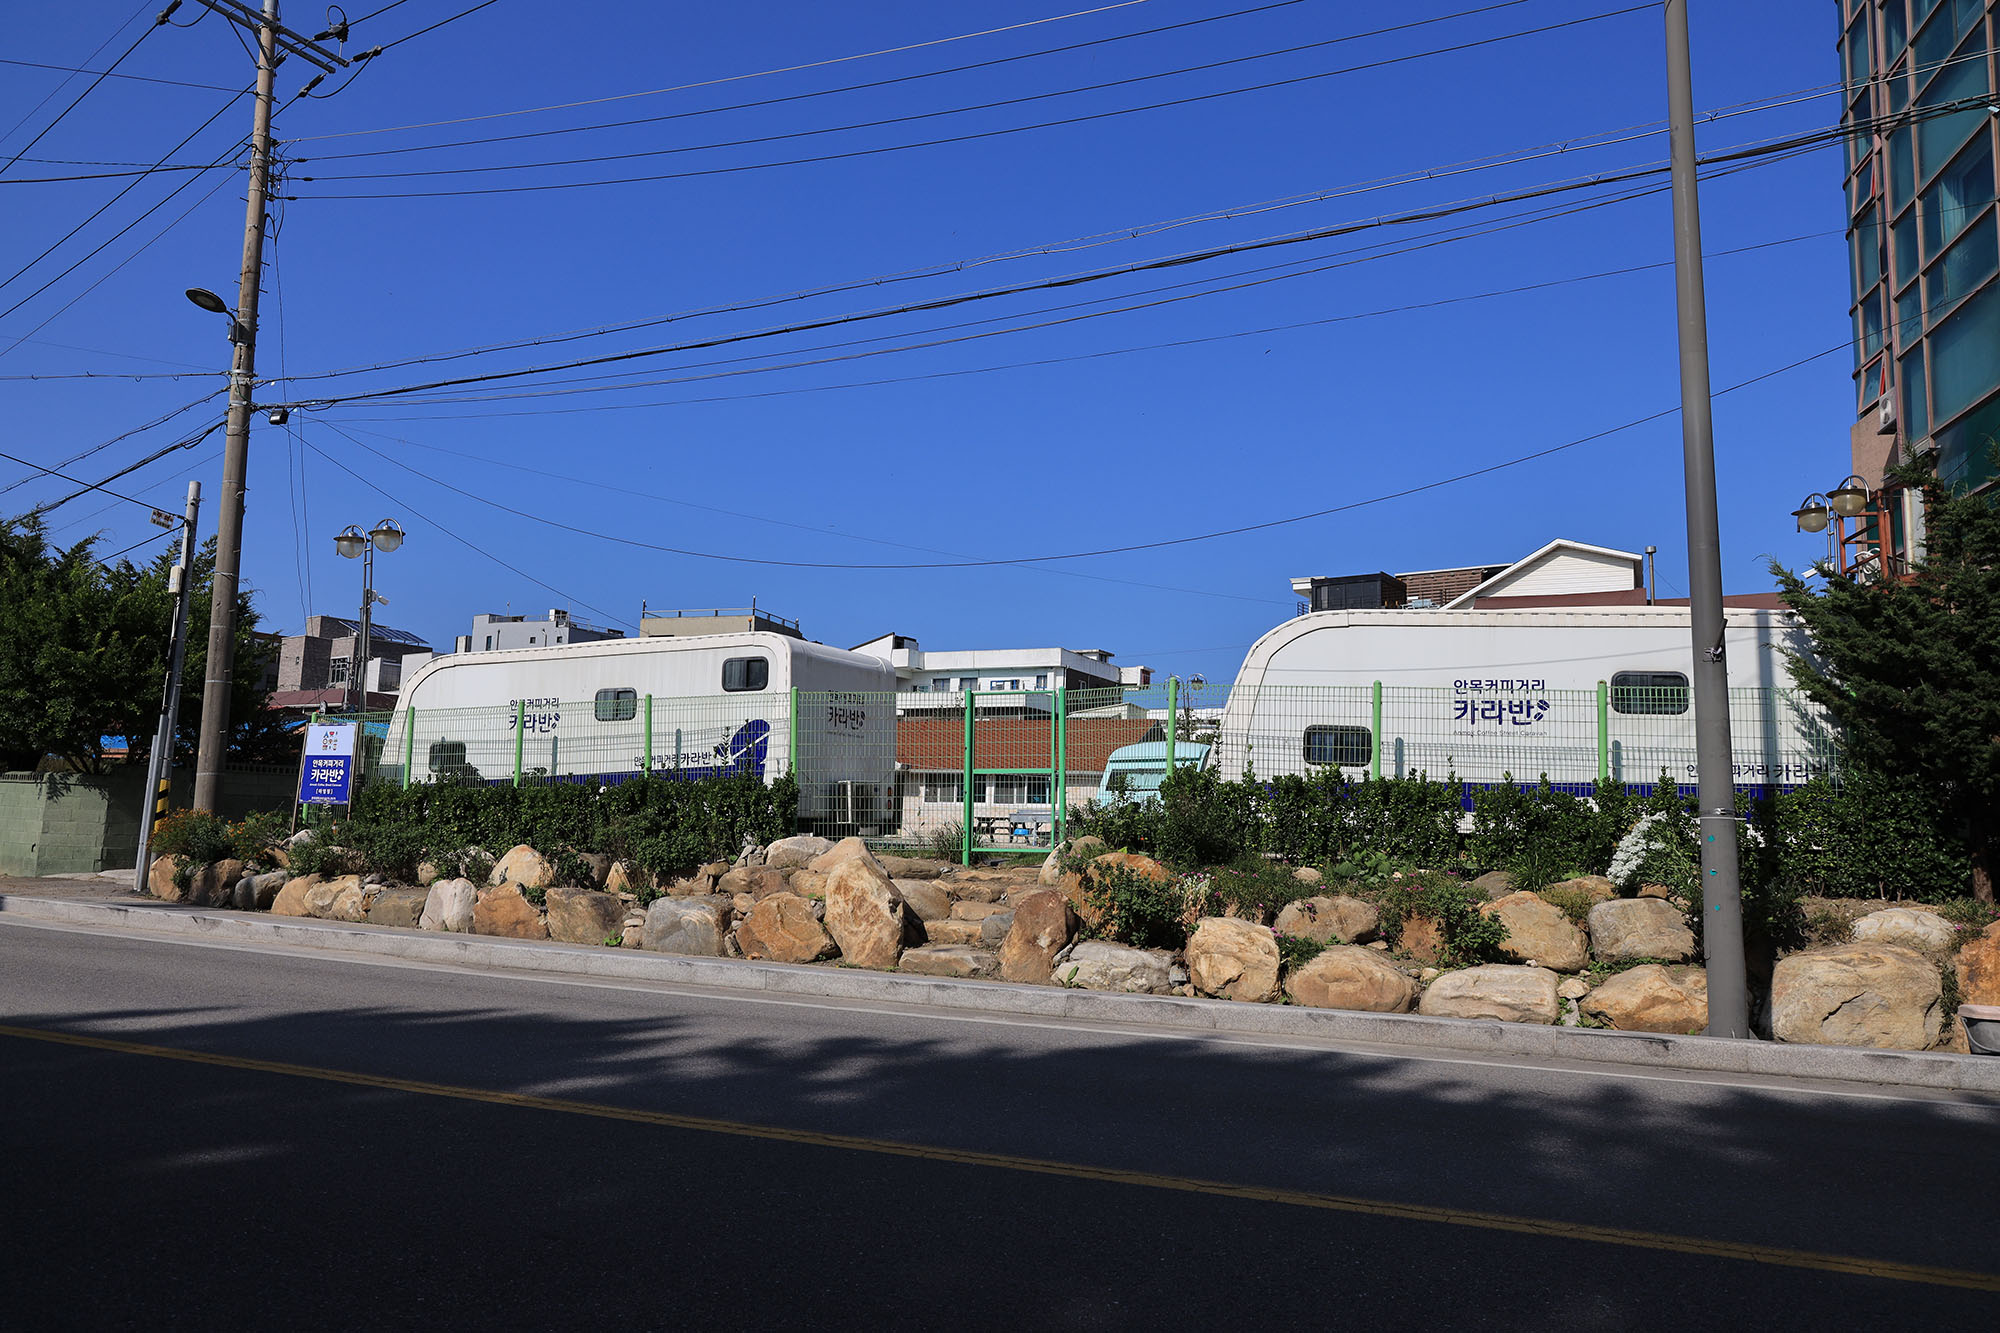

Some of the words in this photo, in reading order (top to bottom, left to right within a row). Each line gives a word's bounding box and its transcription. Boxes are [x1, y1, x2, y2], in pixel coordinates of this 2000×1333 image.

[1453, 679, 1545, 694] 안목커피거리
[509, 697, 560, 711] 안커피거리
[828, 706, 860, 730] 카라반
[1453, 699, 1535, 725] 카라반
[680, 752, 712, 766] 카라반
[310, 769, 339, 783] 카라반
[1686, 764, 1769, 778] 안피거리
